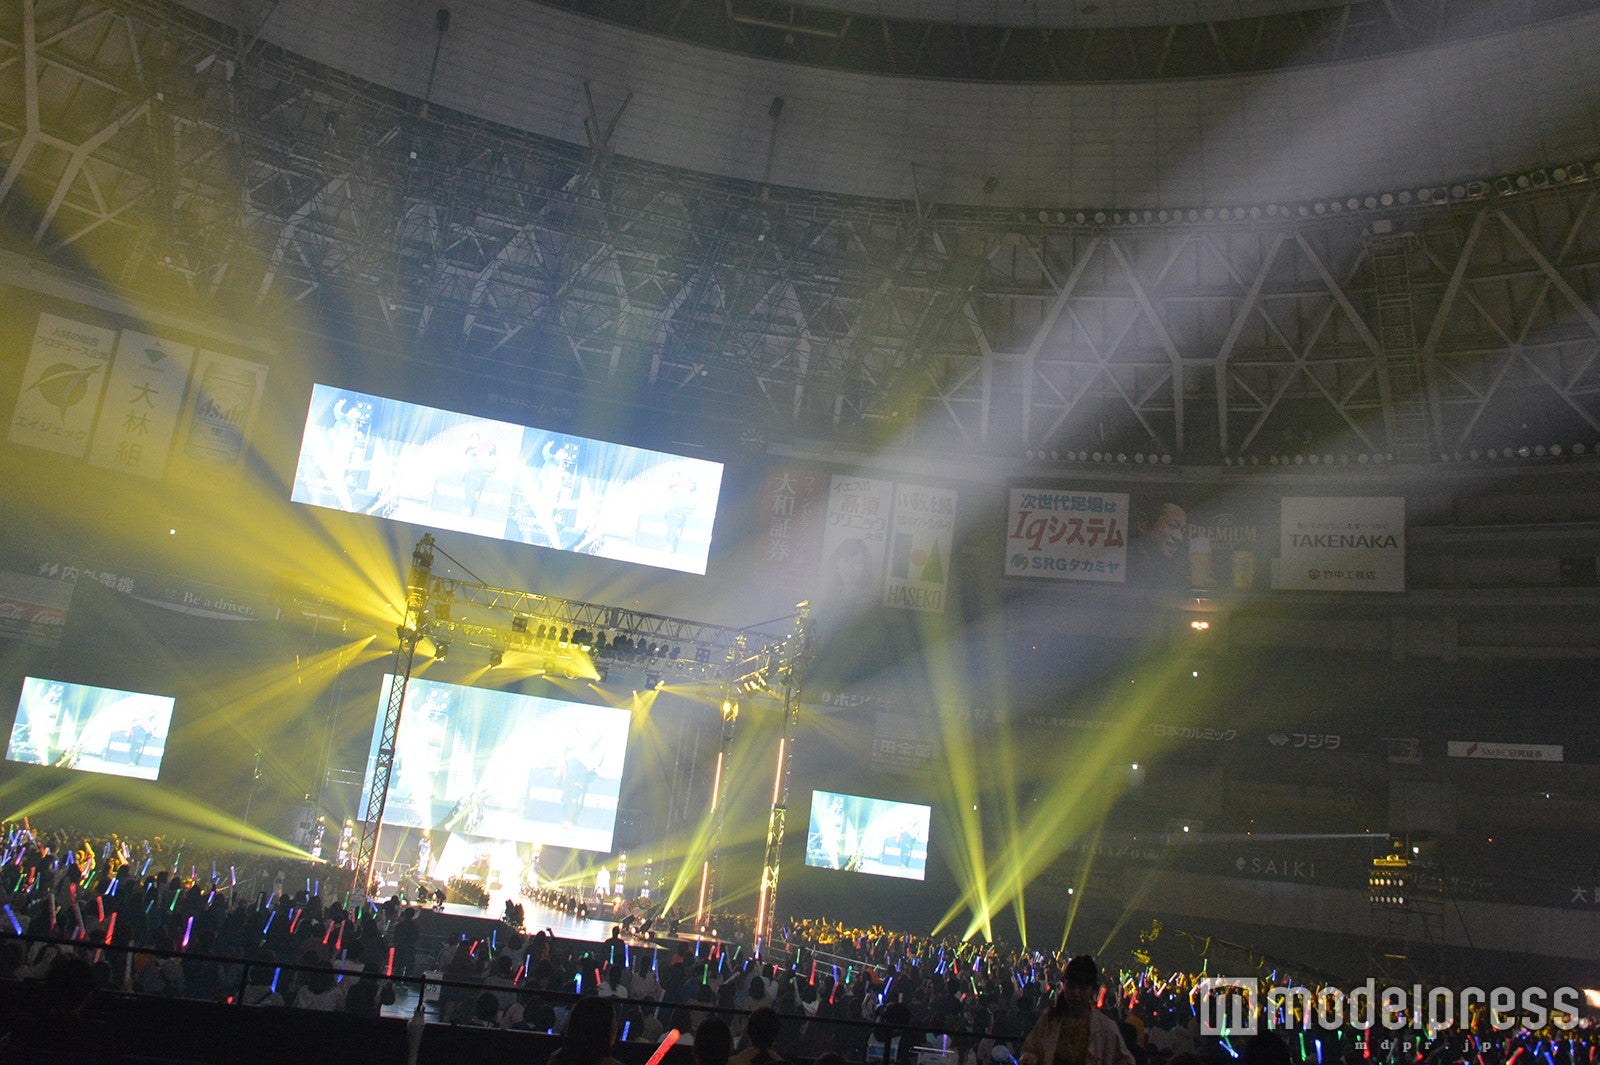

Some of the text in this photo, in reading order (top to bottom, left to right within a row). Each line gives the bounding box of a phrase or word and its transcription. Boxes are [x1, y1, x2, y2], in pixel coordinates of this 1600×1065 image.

[15, 416, 88, 440] エイジェック
[114, 382, 159, 468] 大林組
[1020, 493, 1118, 513] 次世代足場は
[768, 472, 797, 562] 大和証券
[1009, 510, 1125, 552] Iqシステム
[1187, 524, 1259, 543] PREMIUM
[1289, 534, 1398, 548] TAKENAKA
[1031, 556, 1121, 574] SRGタカミヤ
[183, 591, 201, 605] Be
[214, 598, 254, 616] driver.
[887, 584, 942, 610] HASEKO
[1153, 724, 1237, 741] 日本カルミック
[1293, 732, 1342, 750] フジタ
[1251, 857, 1315, 878] SAIKI
